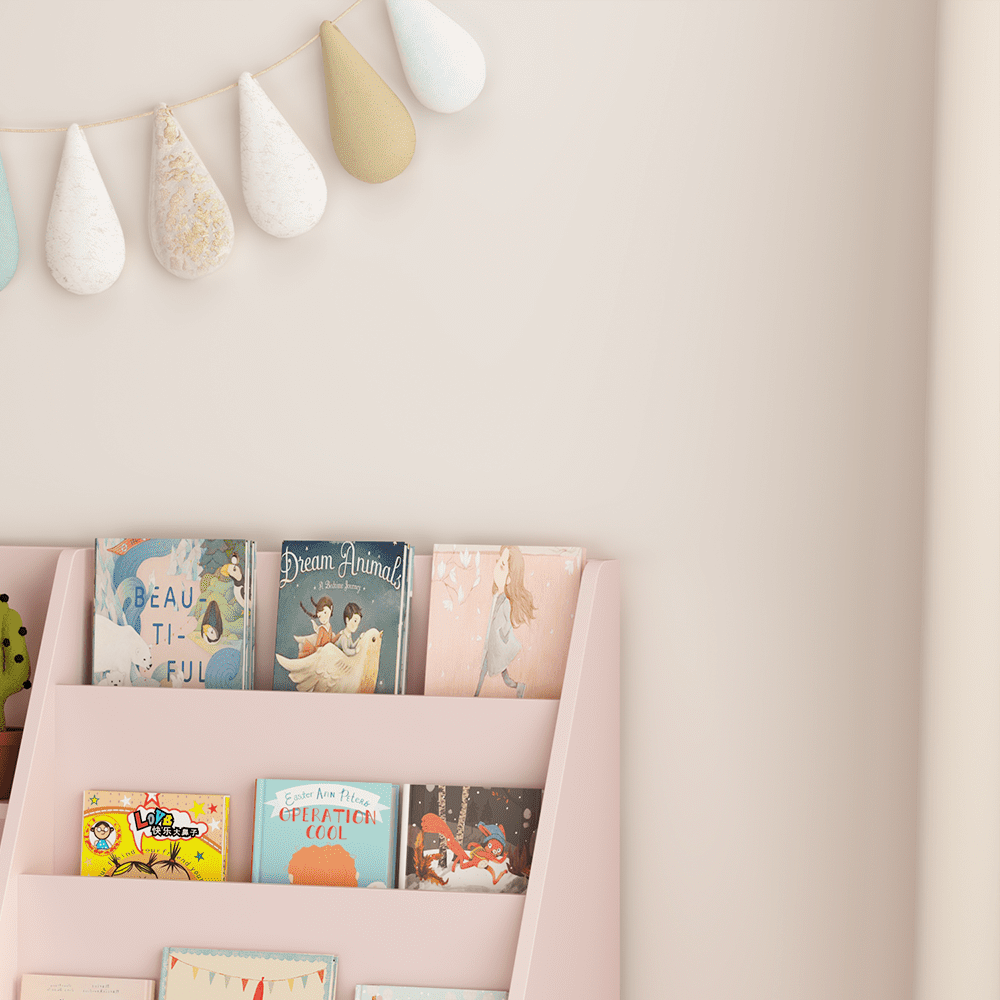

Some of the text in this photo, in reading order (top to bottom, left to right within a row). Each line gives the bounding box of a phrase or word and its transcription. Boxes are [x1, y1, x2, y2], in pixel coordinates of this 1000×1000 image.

[279, 541, 402, 590] Dream Animals
[134, 586, 207, 608] BEAU-
[152, 623, 186, 645] TI-
[167, 660, 206, 683] FUL
[316, 787, 336, 800] Ann
[279, 806, 376, 825] OPERATION
[305, 824, 347, 840] COOL
